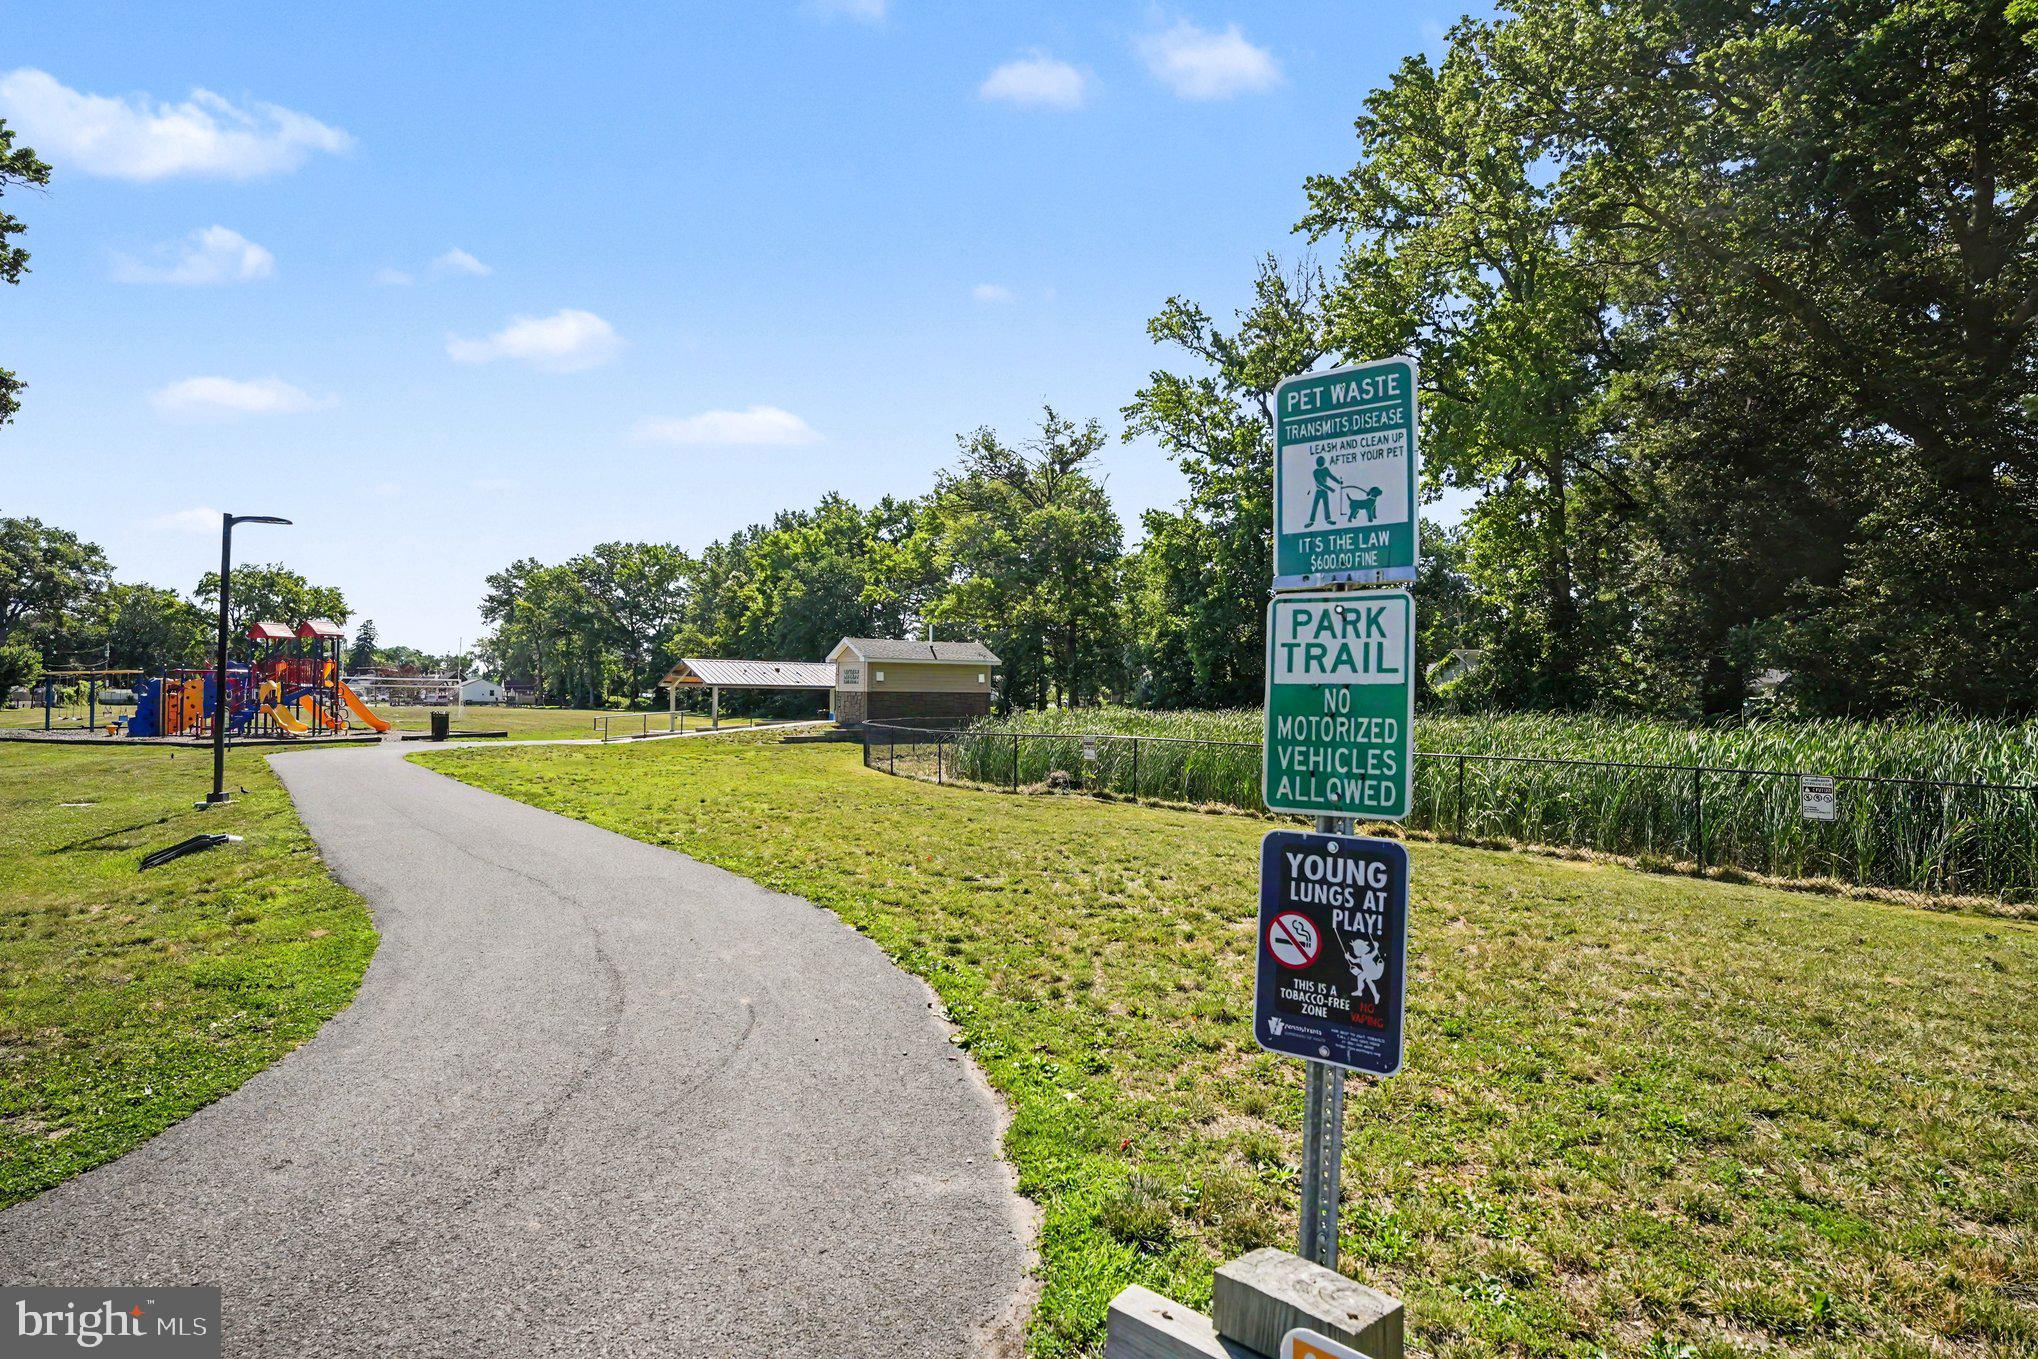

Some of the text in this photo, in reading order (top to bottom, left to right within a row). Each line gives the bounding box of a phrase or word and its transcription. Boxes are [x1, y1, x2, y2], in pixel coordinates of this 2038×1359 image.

[1287, 373, 1401, 412] PET WASTE
[1285, 408, 1404, 440] TRANSMITS DISEASE
[1309, 432, 1404, 456] LEASH AND CLEAN UP
[1329, 446, 1404, 466] AFTER YOUR PET
[1299, 530, 1390, 554] IT'S THE LAW
[1311, 551, 1378, 572] $600.00 FINE
[1292, 606, 1387, 640] PARK
[1280, 641, 1399, 674] TRAIL
[1324, 688, 1350, 714] NO
[1277, 715, 1398, 744] MOTORIZED
[1277, 745, 1397, 776] VEHICLES
[1276, 776, 1396, 807] ALLOWED
[1286, 852, 1387, 889] YOUNG
[1290, 880, 1387, 912] LUNGS AT
[1332, 908, 1383, 936] PLAY!
[1280, 987, 1351, 1011] TOBACCO-FREE
[1293, 979, 1337, 995] THIS IS A
[1301, 1003, 1328, 1019] ZONE
